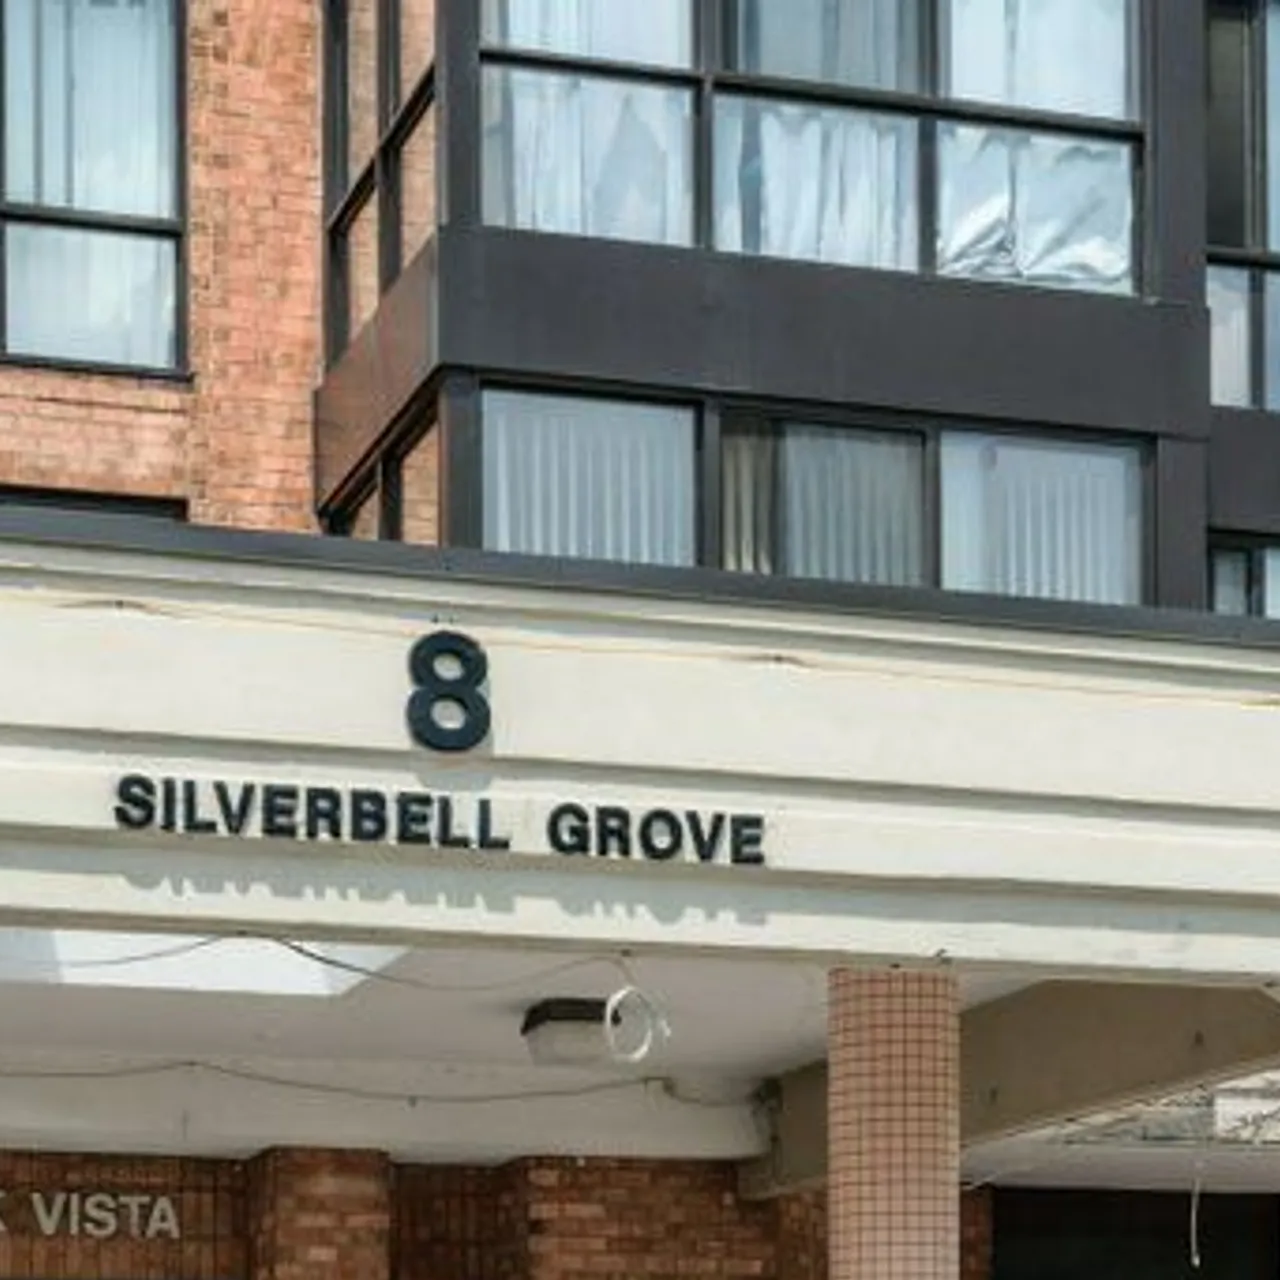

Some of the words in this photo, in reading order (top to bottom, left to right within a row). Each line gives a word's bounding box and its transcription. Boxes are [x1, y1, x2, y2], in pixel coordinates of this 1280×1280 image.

[406, 630, 491, 753] 8
[113, 773, 511, 852] SILVERBELL
[546, 802, 766, 864] GROVE
[29, 1190, 181, 1240] VISTA
